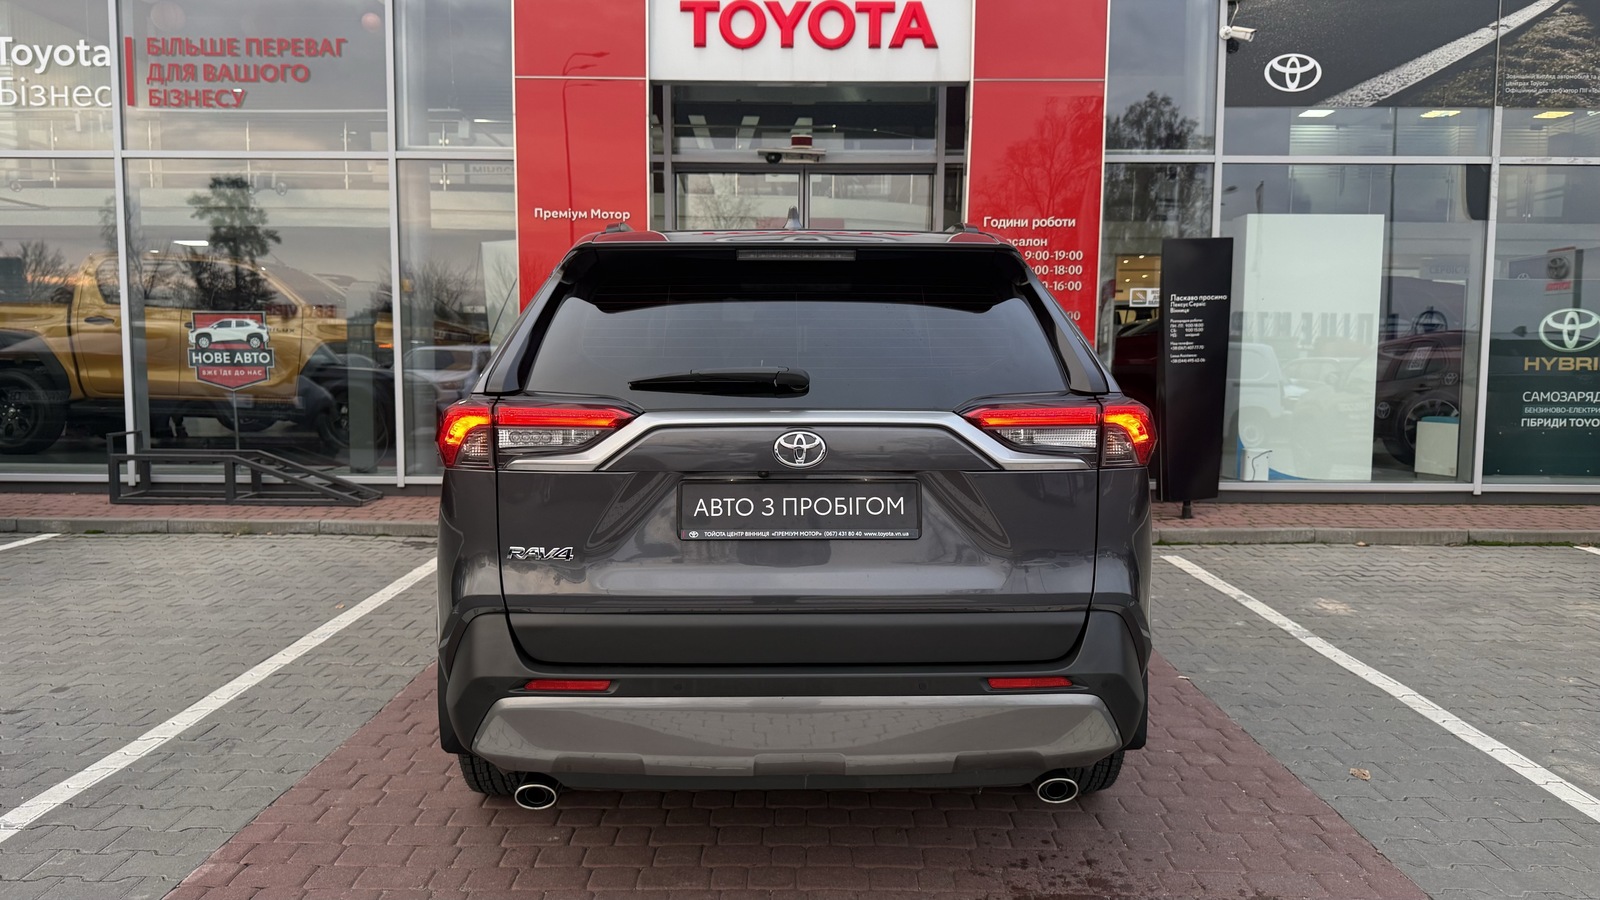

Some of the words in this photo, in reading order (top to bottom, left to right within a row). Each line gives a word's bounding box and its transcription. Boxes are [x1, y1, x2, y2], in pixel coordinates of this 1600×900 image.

[680, 0, 939, 50] TOYOTA
[146, 37, 240, 57] БІЛЬШЕ
[245, 38, 348, 57] ПЕРЕВАГ
[0, 36, 111, 74] Toyota
[146, 63, 196, 84] ДЛЯ
[203, 64, 311, 83] ВАШОГО
[0, 76, 112, 107] Бізнес
[148, 88, 245, 107] БІЗНЕСУ
[534, 207, 588, 221] Преміум
[590, 208, 631, 222] Мотор
[983, 216, 1029, 229] Години
[1031, 216, 1076, 229] роботи
[1032, 265, 1083, 276] :00-18:00
[192, 352, 231, 364] НОВЕ
[234, 352, 270, 364] АВТО
[1524, 357, 1600, 371] HYBRI
[220, 368, 231, 376] ЇДЕ
[1521, 418, 1567, 428] ГІБРИДИ
[694, 498, 754, 517] АВТО
[761, 498, 775, 516] З
[783, 496, 905, 516] ПРОБІГОМ
[507, 546, 574, 561] RAV4
